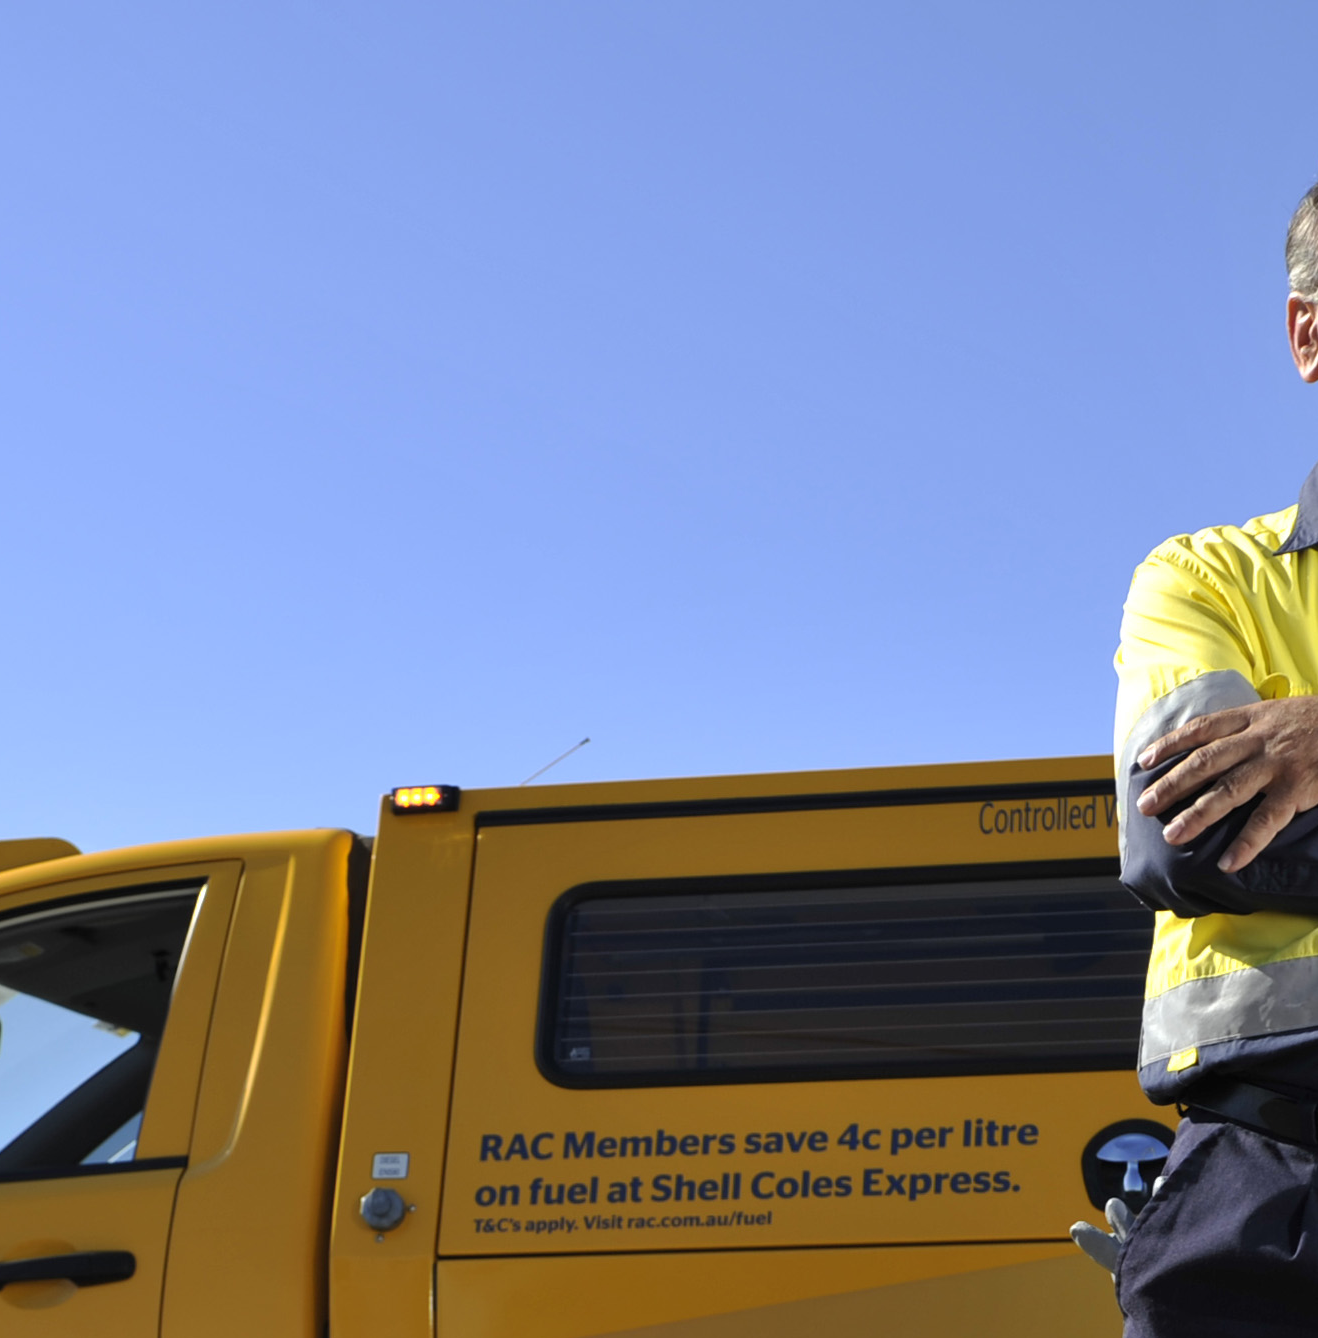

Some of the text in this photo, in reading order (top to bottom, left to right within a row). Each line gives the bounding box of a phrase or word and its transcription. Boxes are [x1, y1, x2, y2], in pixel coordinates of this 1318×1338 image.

[979, 797, 1097, 835] Controlled
[479, 1118, 1040, 1162] RAC Members save 4c per litre
[474, 1168, 1021, 1207] on fuel at Shell Coles Express.
[473, 1210, 773, 1235] T&C's apply. Visit rac.com.au/fuel
